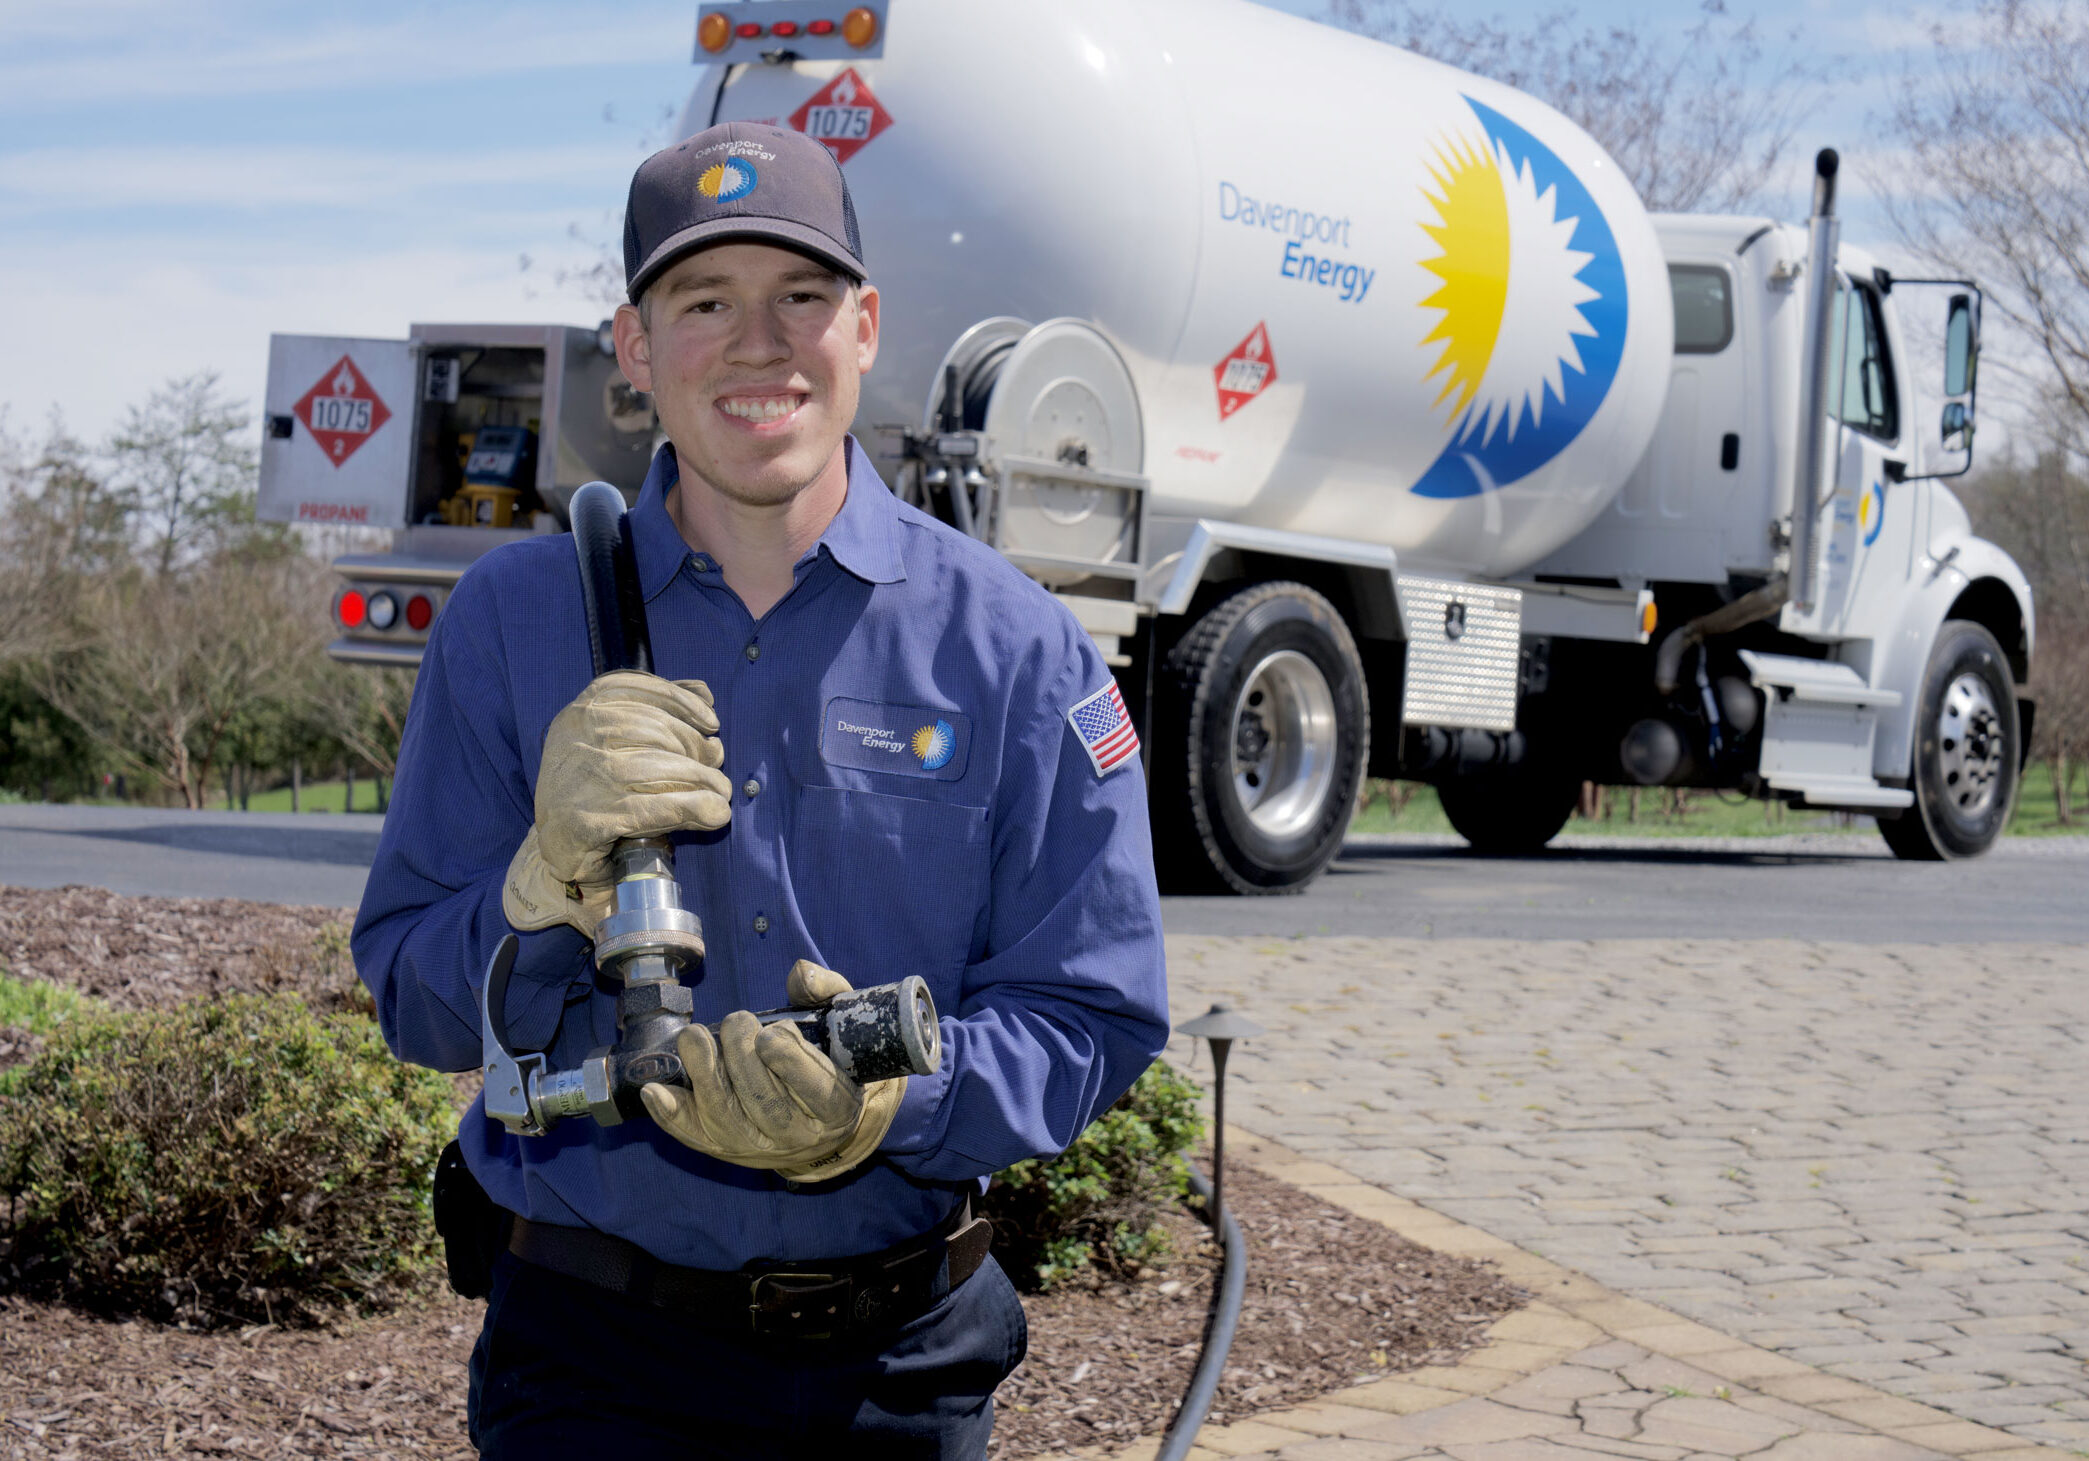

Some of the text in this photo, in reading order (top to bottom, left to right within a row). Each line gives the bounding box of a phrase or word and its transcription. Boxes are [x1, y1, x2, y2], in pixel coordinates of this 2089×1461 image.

[810, 109, 868, 137] 1075
[695, 140, 764, 159] Davenport
[727, 147, 776, 161] Energy
[1219, 181, 1352, 248] Davenport
[1280, 241, 1375, 303] Energy
[317, 401, 369, 430] 1075
[299, 502, 368, 522] PROPANE
[837, 720, 895, 740] Davenport
[862, 736, 906, 753] Energy
